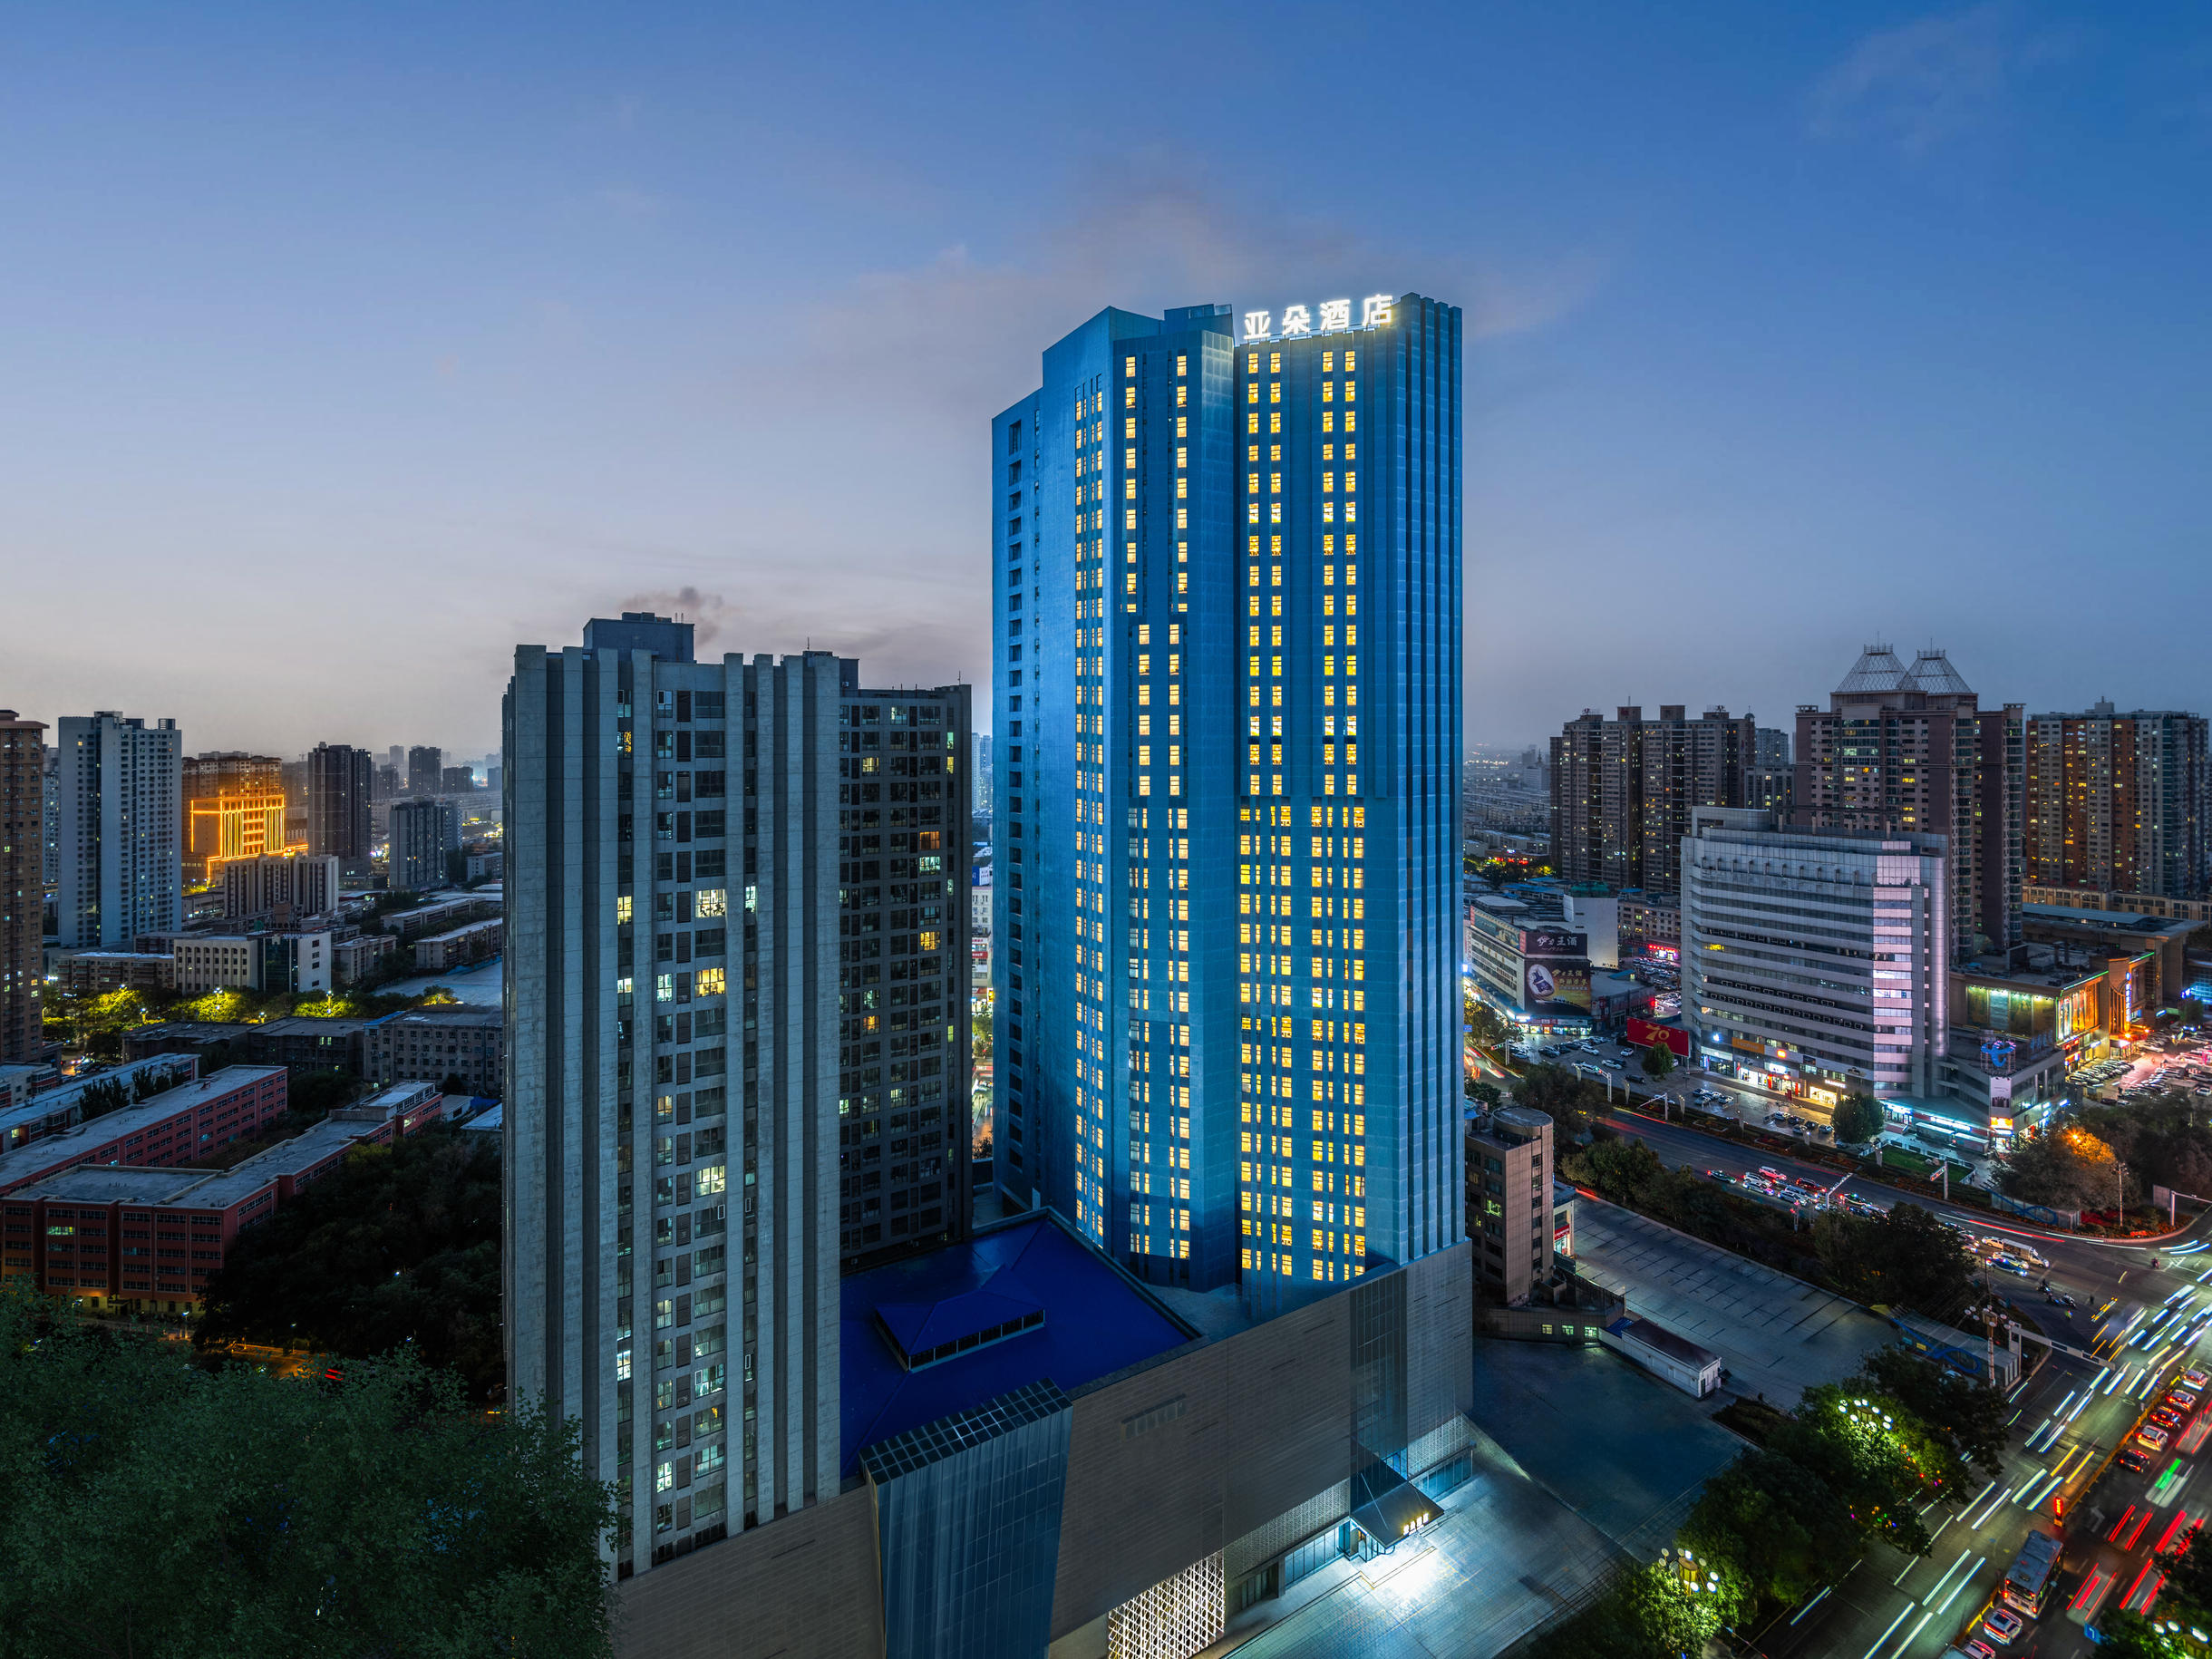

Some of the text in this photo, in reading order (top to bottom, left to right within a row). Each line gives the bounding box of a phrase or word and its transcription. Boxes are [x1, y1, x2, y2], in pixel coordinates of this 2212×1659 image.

[1243, 295, 1393, 339] 亚朵酒店
[1645, 1024, 1670, 1041] 70
